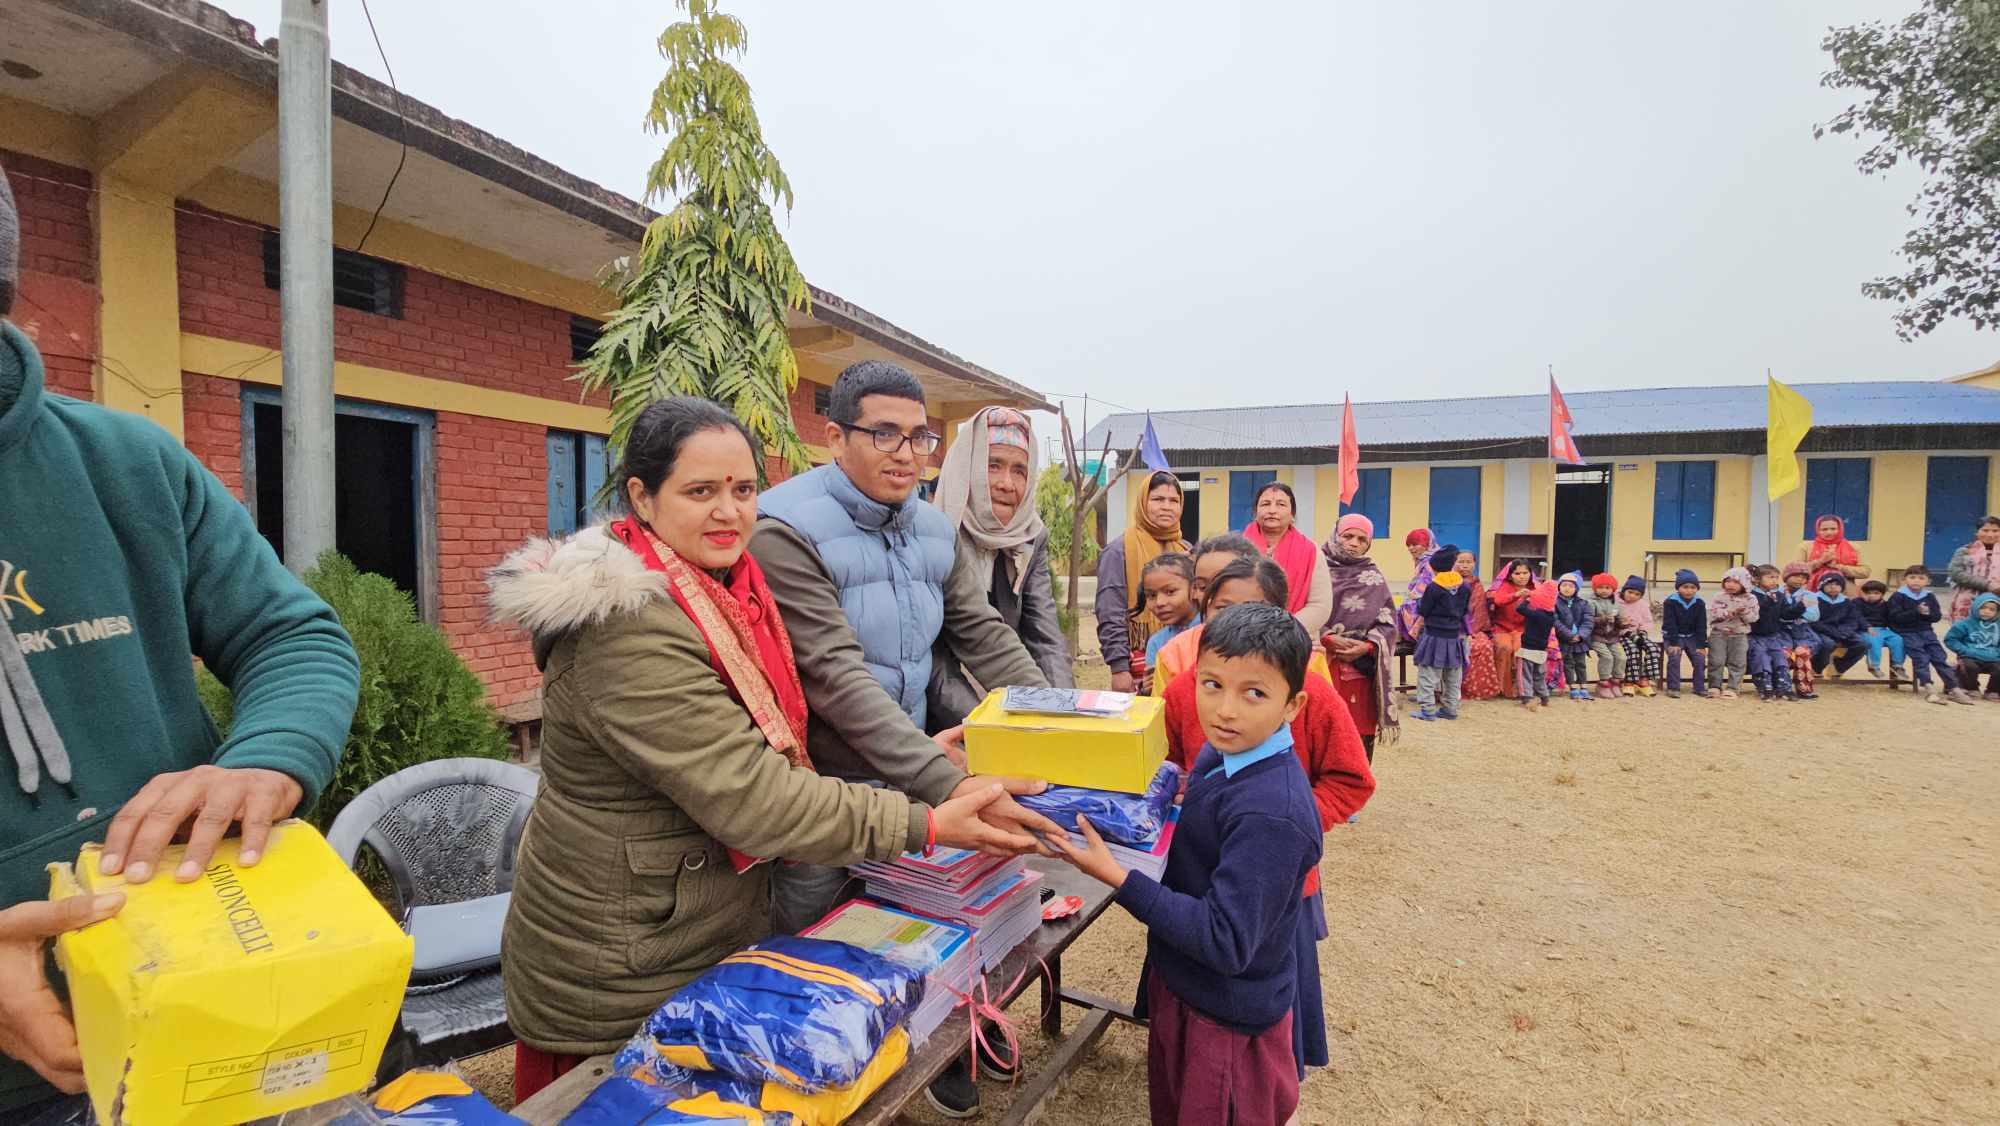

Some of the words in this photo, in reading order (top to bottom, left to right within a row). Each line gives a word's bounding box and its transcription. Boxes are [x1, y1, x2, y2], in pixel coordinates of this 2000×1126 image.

[17, 629, 57, 654] RK
[50, 615, 133, 645] TIMES
[207, 863, 272, 954] SIMONCELLI
[208, 1065, 235, 1075] STYLE
